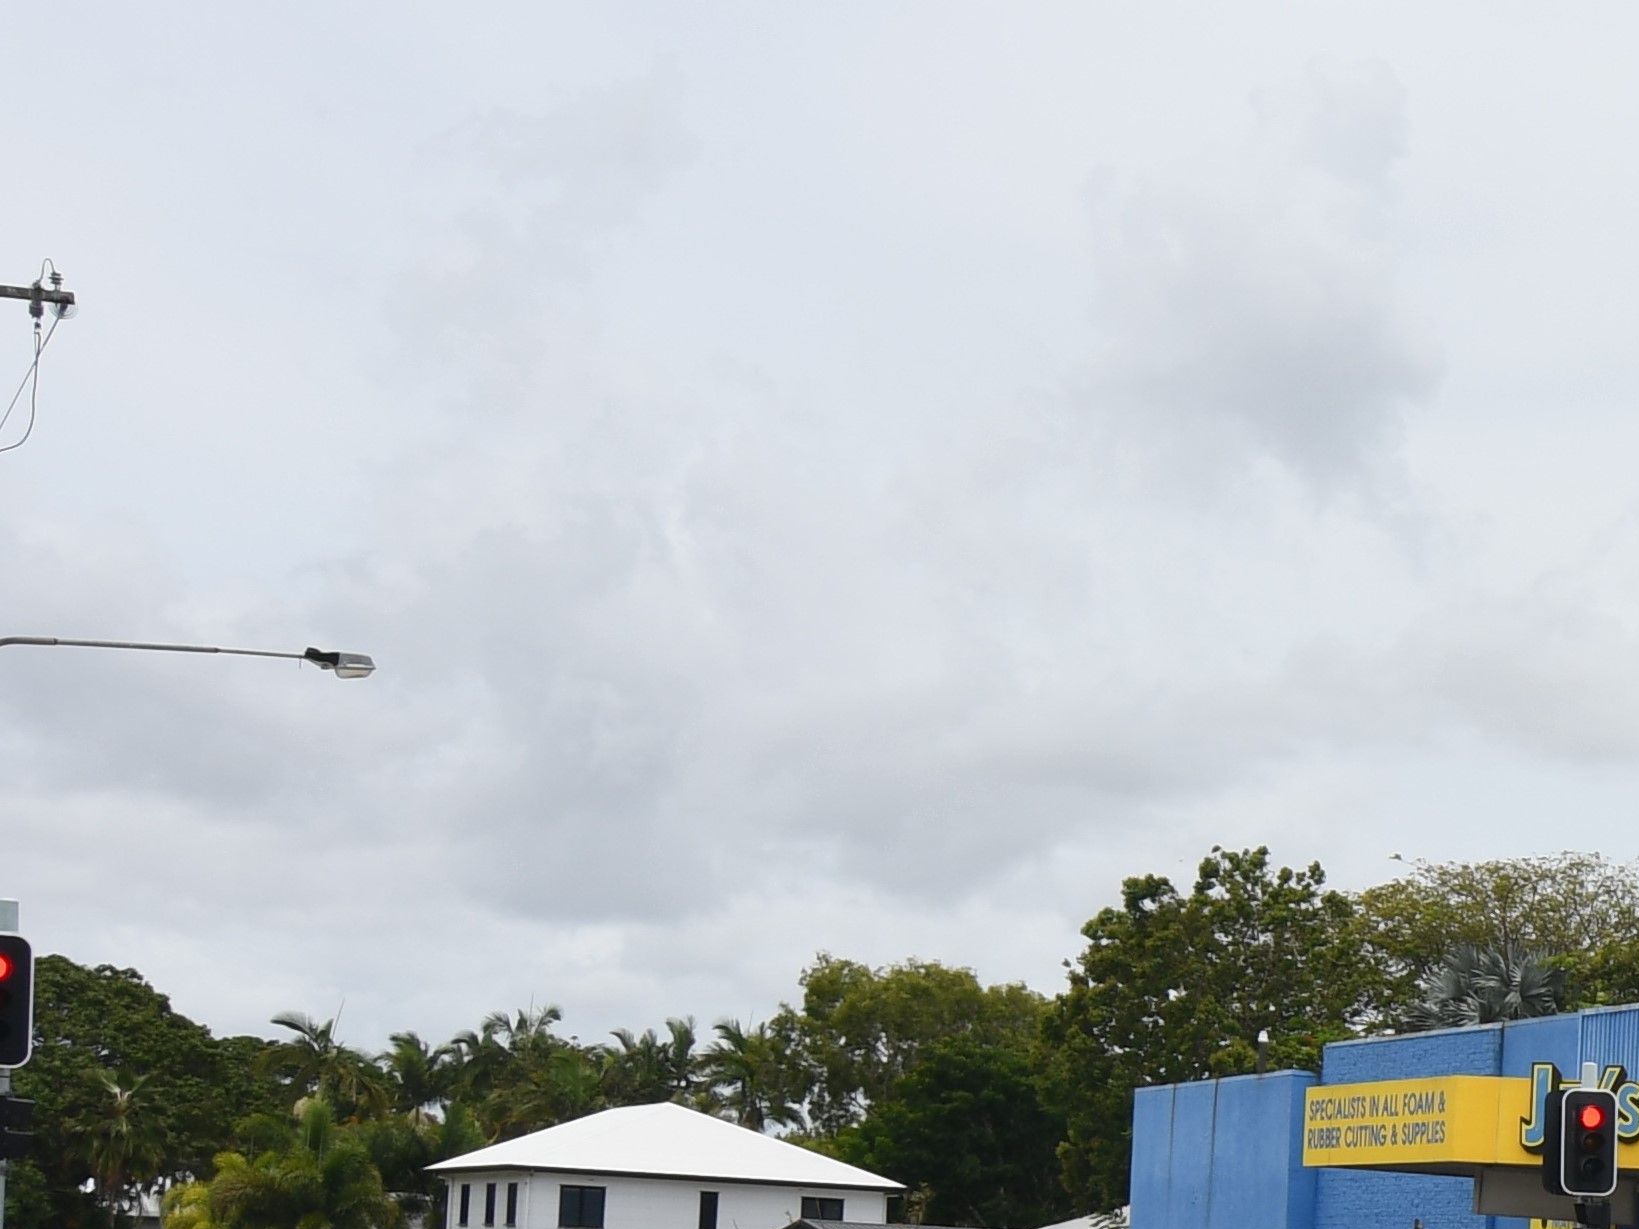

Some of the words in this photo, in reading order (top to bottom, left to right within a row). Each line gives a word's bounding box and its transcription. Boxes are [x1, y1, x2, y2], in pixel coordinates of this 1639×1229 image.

[1309, 1096, 1367, 1121] SPECIALISTS
[1369, 1095, 1380, 1118] IN
[1382, 1094, 1398, 1117] ALL
[1402, 1091, 1435, 1116] FOAM
[1438, 1090, 1446, 1114] &
[1308, 1127, 1341, 1149] RUBBER
[1344, 1124, 1387, 1148] CUTTING
[1391, 1124, 1397, 1146] &
[1402, 1120, 1446, 1145] SUPPLIES
